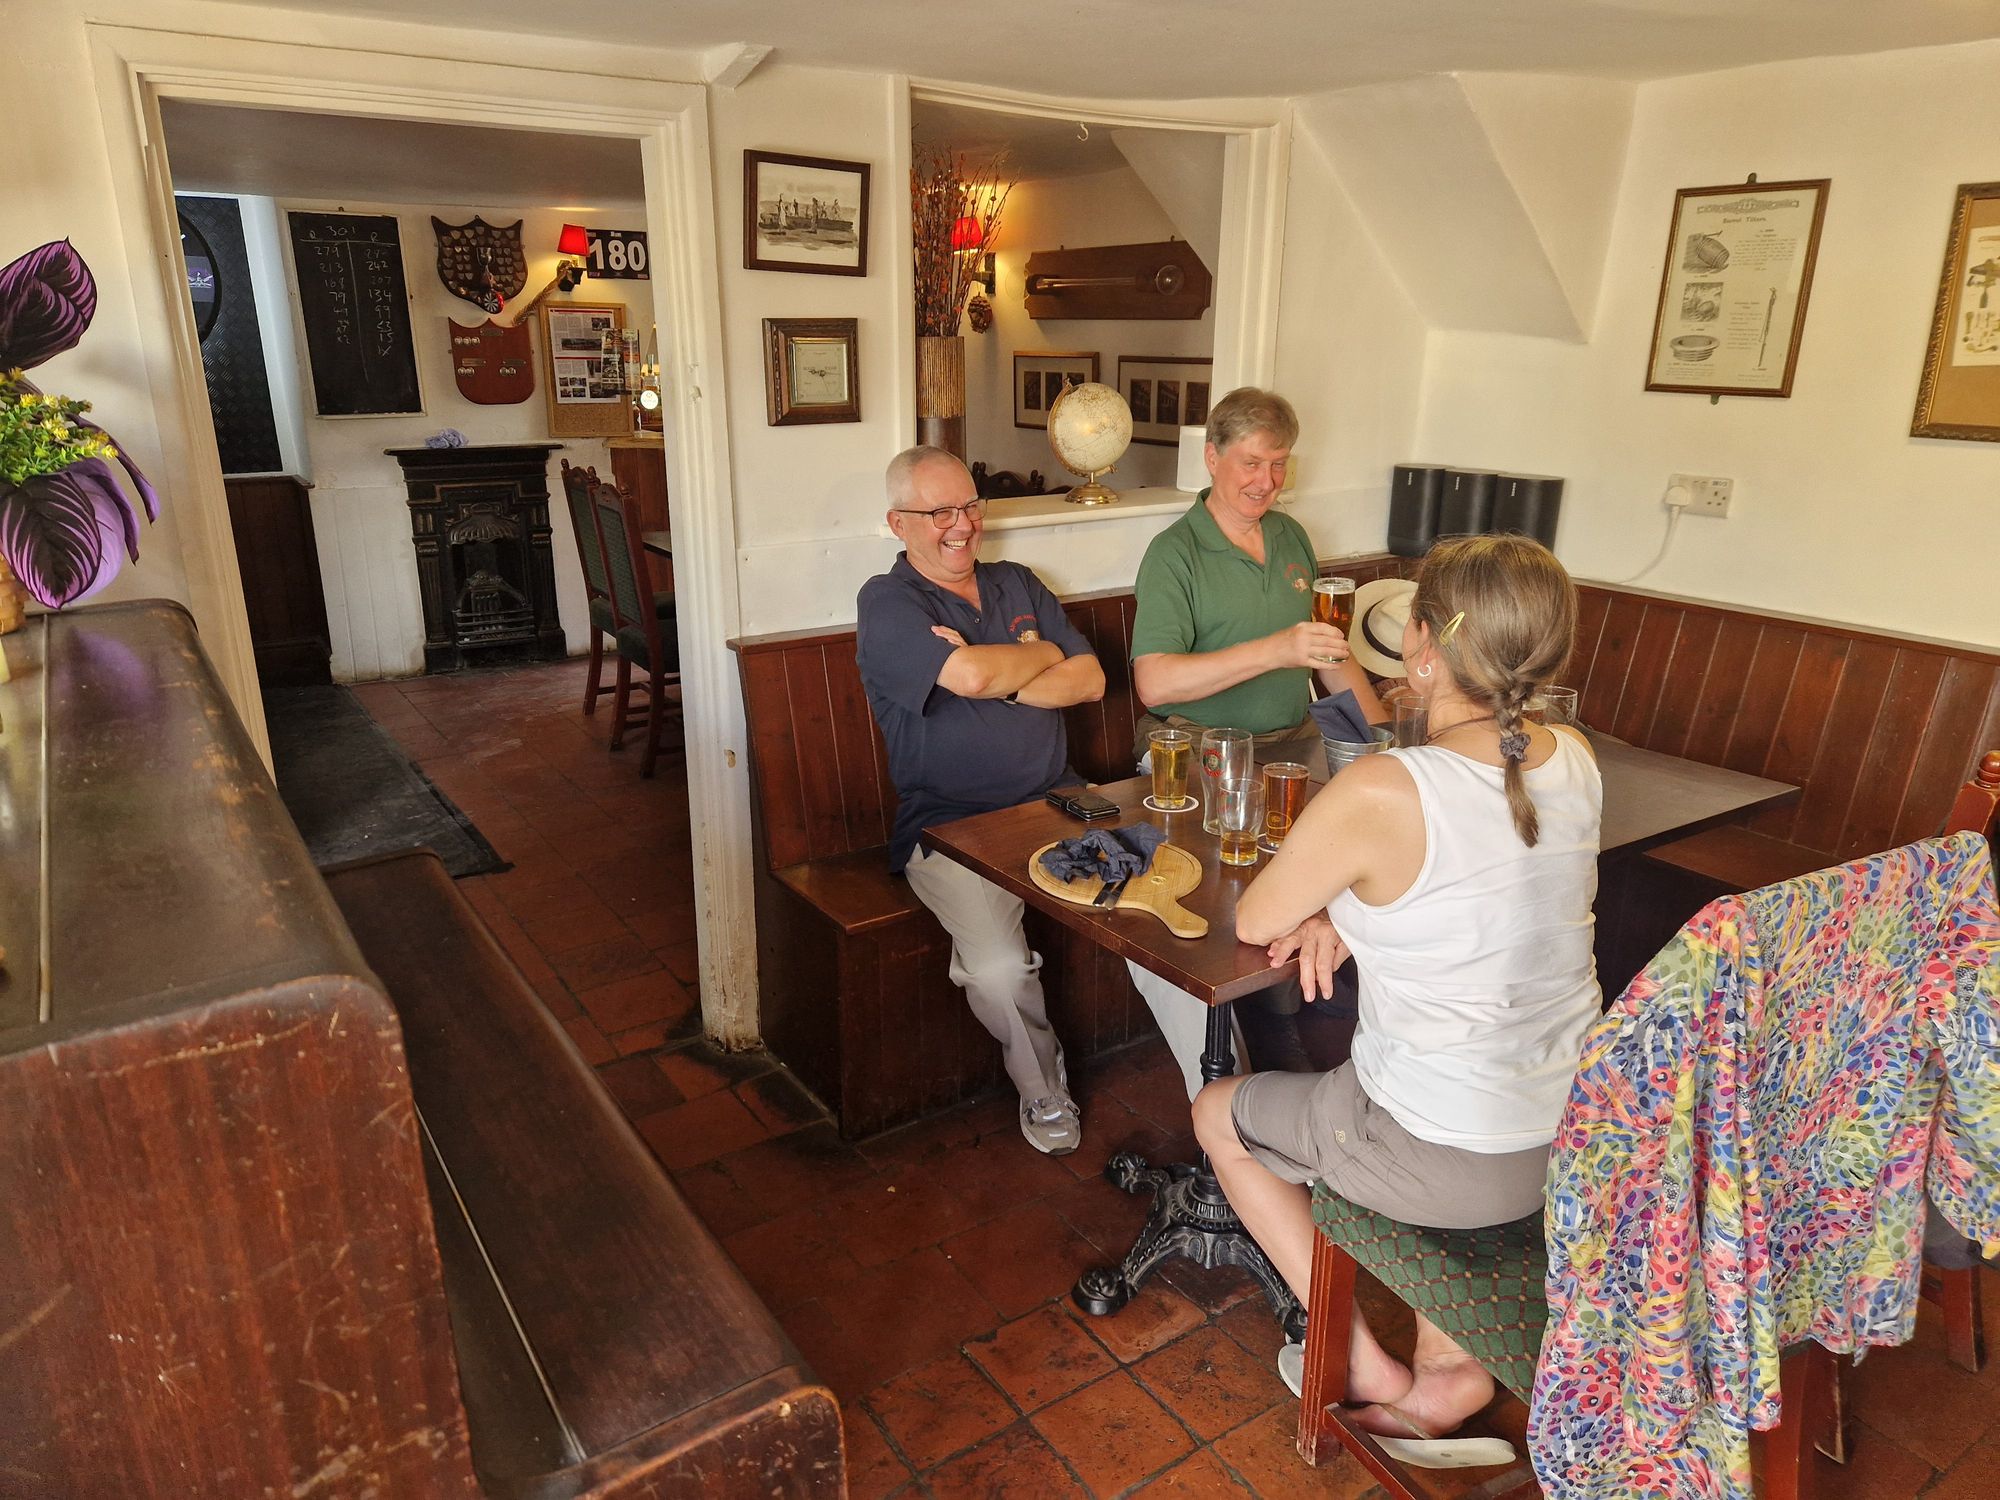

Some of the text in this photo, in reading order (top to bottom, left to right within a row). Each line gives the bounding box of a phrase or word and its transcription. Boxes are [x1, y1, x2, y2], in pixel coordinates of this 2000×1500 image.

[326, 225, 356, 236] 301
[314, 246, 340, 258] 279
[588, 239, 646, 271] 180
[319, 260, 389, 273] 213 242
[329, 289, 392, 304] 79 134
[375, 305, 391, 319] 99
[380, 332, 394, 343] 15
